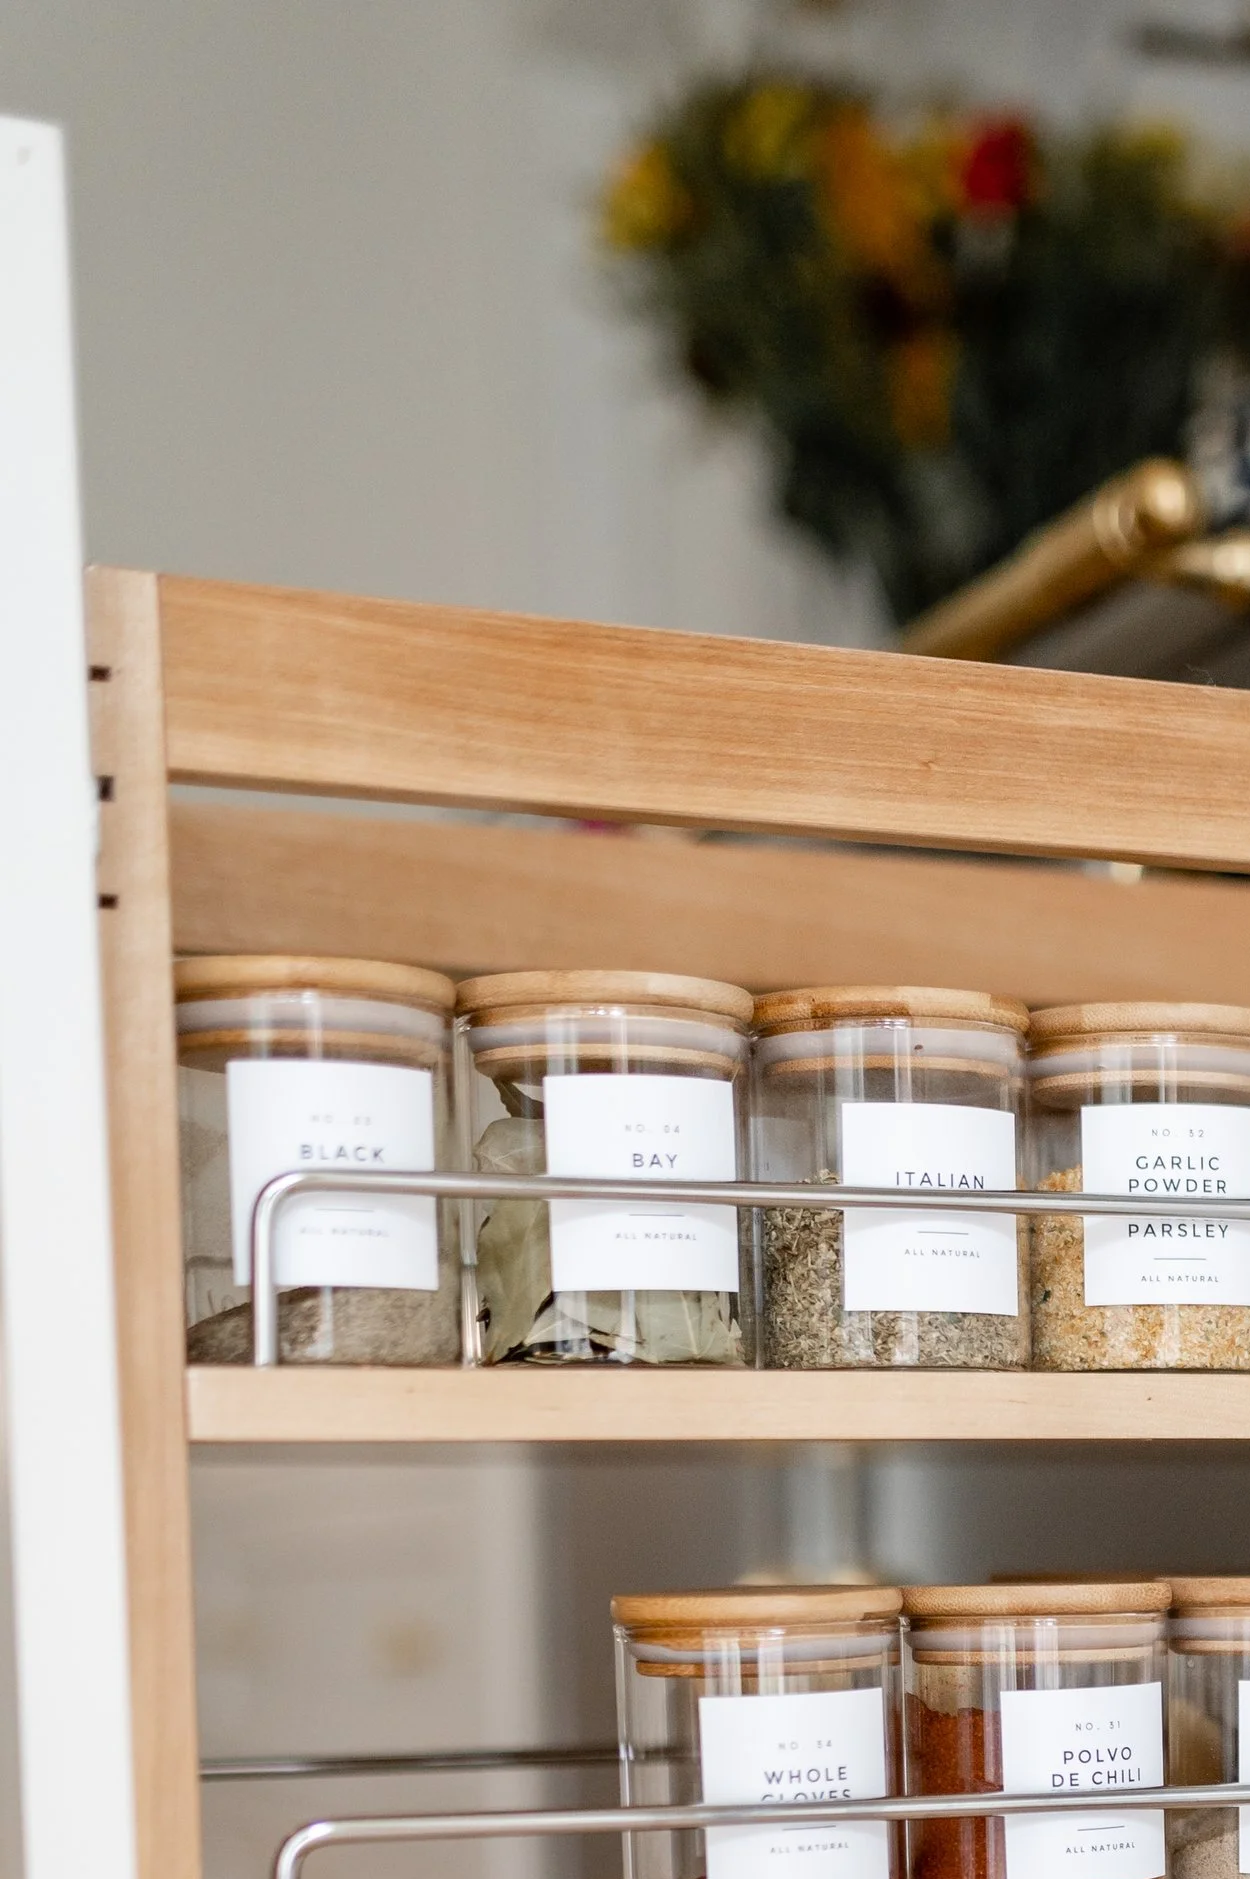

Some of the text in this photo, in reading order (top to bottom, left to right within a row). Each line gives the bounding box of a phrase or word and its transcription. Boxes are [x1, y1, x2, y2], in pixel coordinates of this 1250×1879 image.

[300, 1144, 385, 1163] BLACK
[632, 1153, 678, 1168] BAY
[1136, 1155, 1220, 1170] GARLIC
[896, 1171, 984, 1189] ITALIAN
[1128, 1178, 1227, 1194] POWDER
[615, 1232, 697, 1241] ALL NATURAL
[1128, 1223, 1229, 1238] PARSLEY
[932, 1249, 980, 1258] NATURAL
[1168, 1275, 1219, 1283] NATURAL
[1075, 1720, 1120, 1731] NO. 31
[1063, 1746, 1132, 1765] POLVO
[764, 1766, 848, 1785] WHOLE
[1052, 1767, 1141, 1787] DE CHILI
[1091, 1842, 1135, 1852] NATURAL
